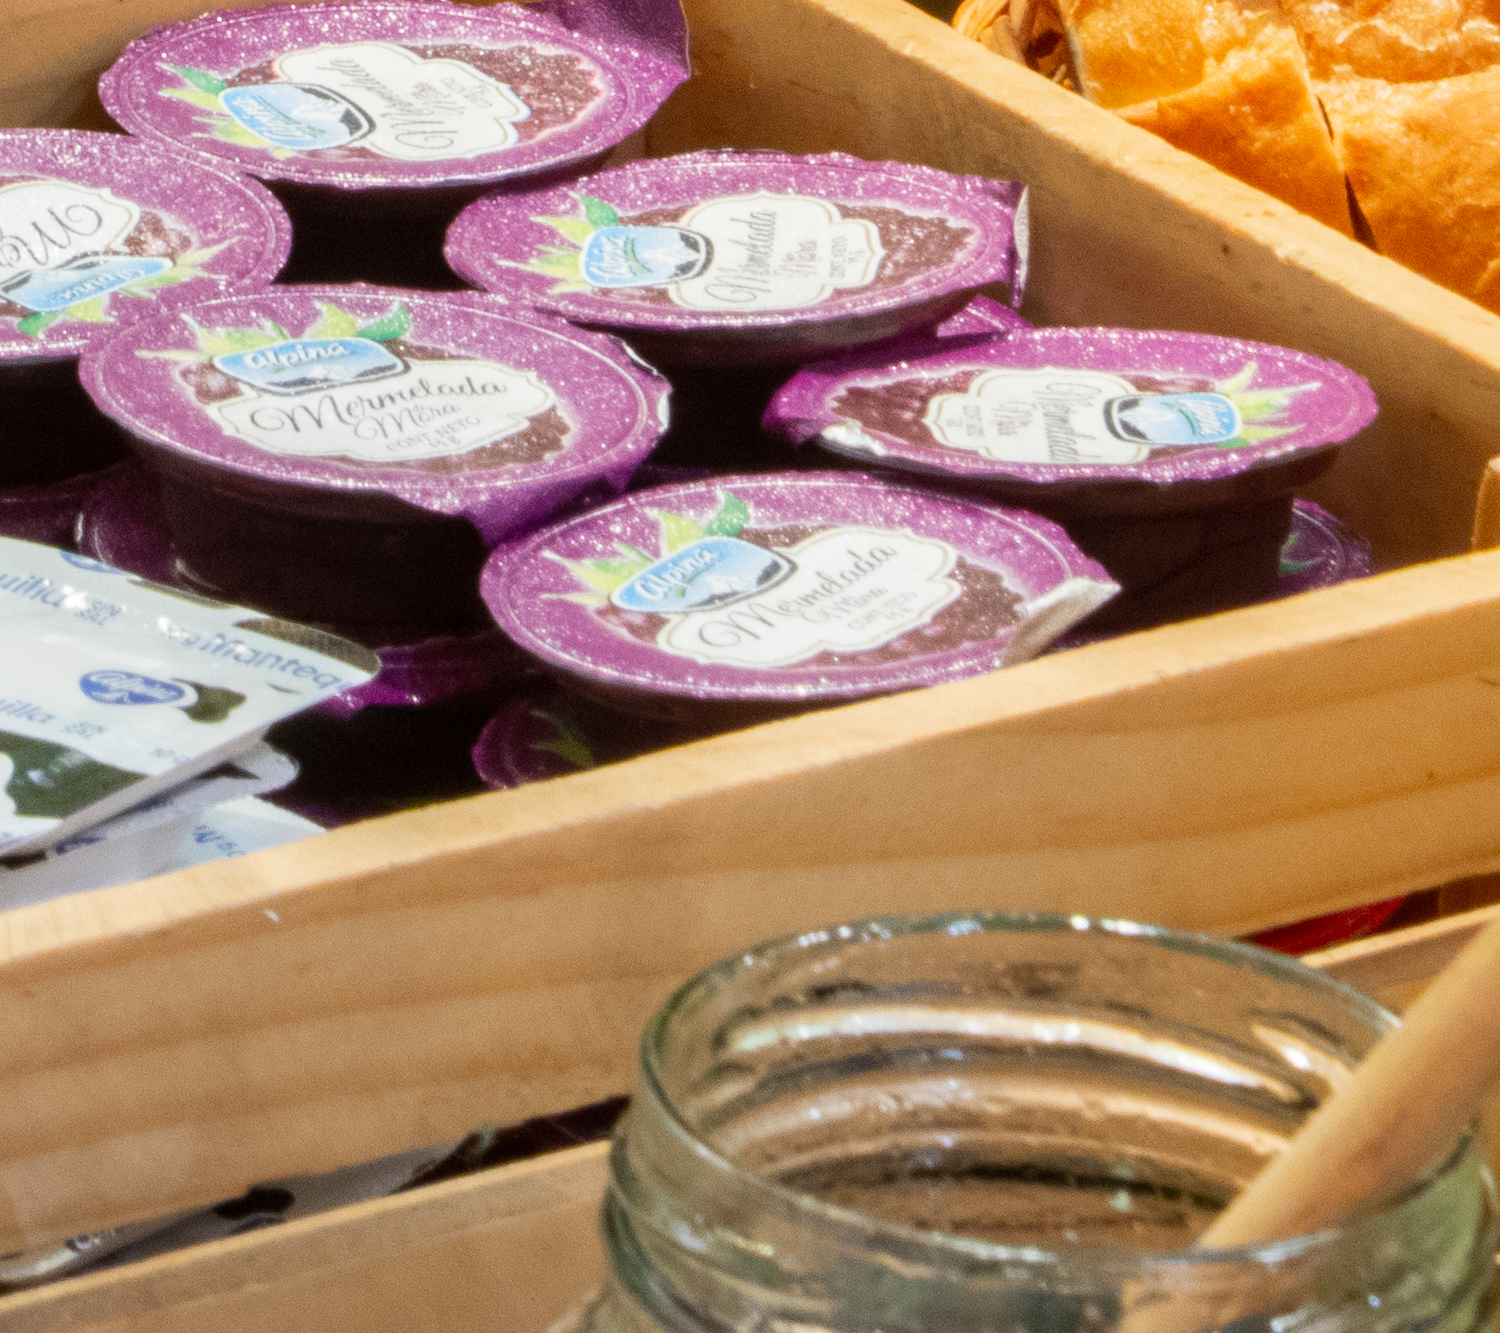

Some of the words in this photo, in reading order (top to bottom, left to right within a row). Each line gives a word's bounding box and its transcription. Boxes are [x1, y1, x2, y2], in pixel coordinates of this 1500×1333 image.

[250, 376, 508, 434] Mermelada
[354, 403, 461, 441] Mora
[698, 543, 898, 649] Mermelada
